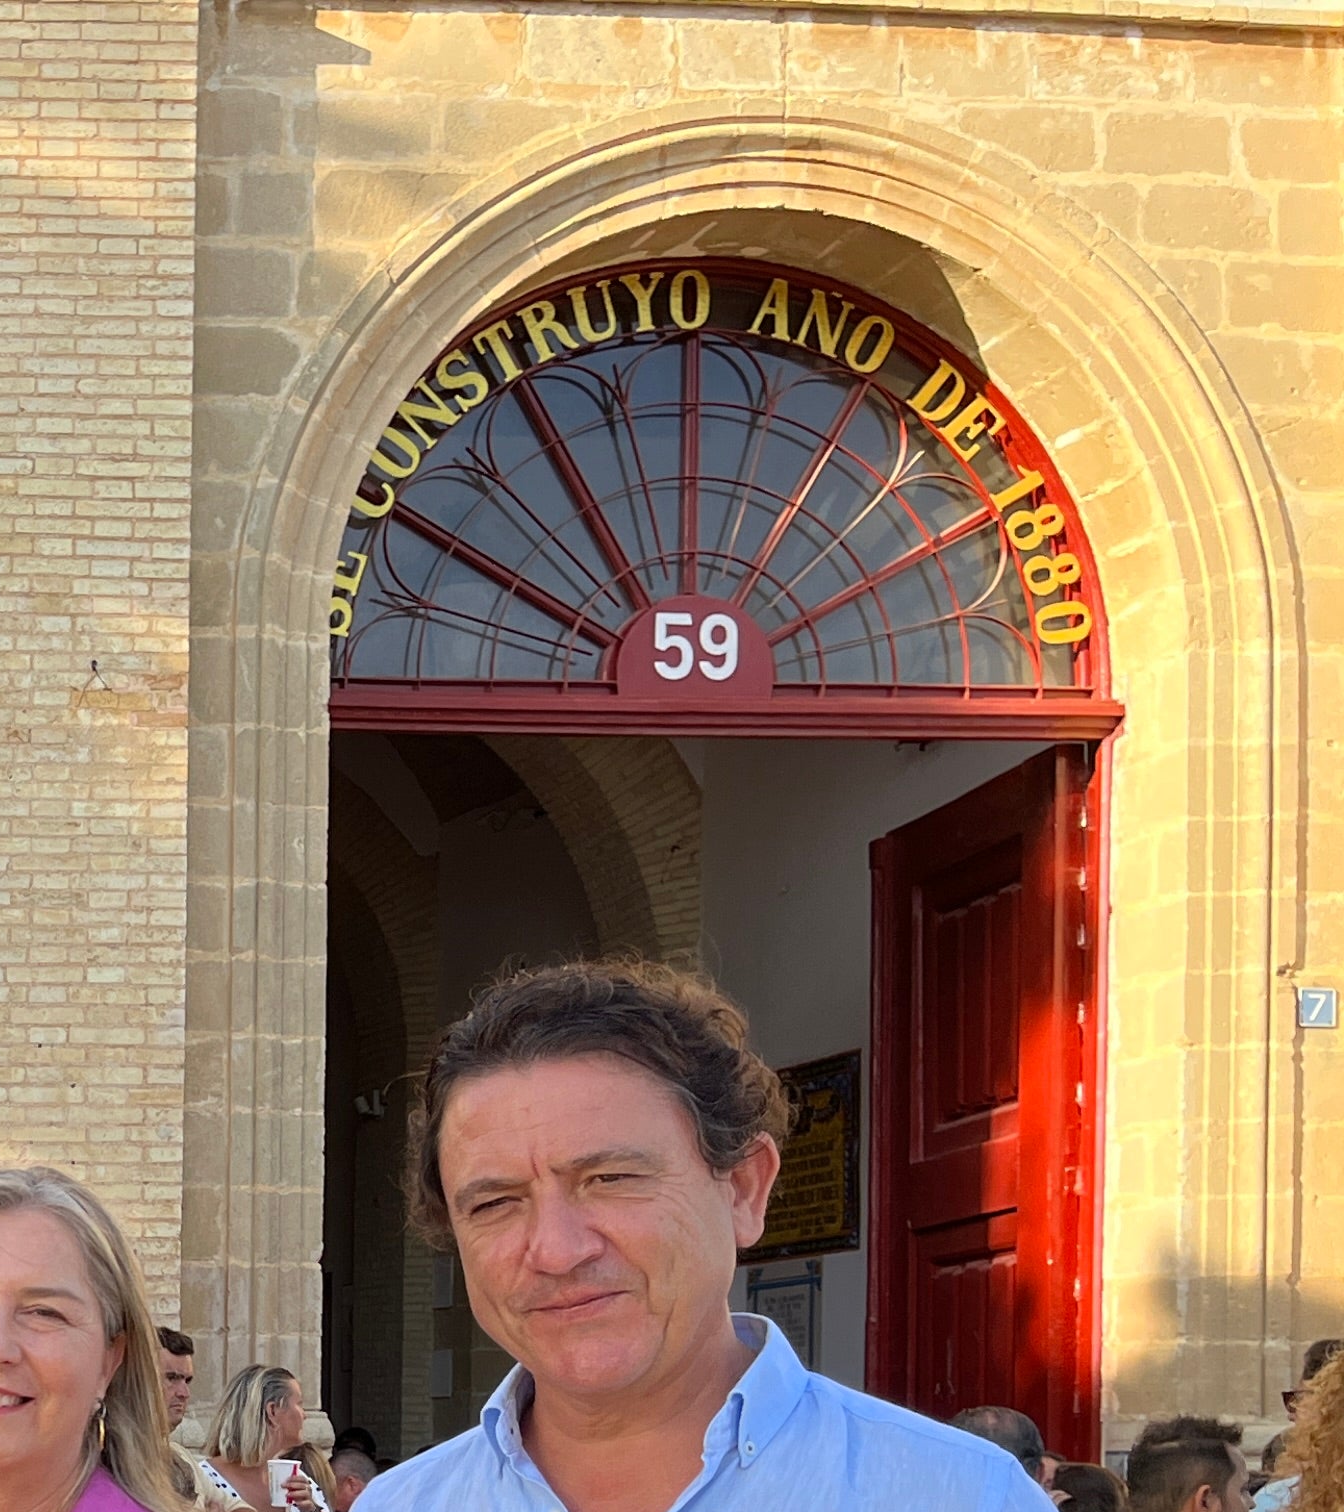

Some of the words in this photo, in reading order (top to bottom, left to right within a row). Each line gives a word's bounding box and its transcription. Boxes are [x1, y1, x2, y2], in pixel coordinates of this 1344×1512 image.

[352, 269, 712, 520] CONSTRUYO
[747, 278, 896, 374] AÑO
[905, 358, 1008, 463] DE
[989, 464, 1093, 645] 1880
[653, 611, 739, 681] 59
[1307, 992, 1327, 1022] 7
